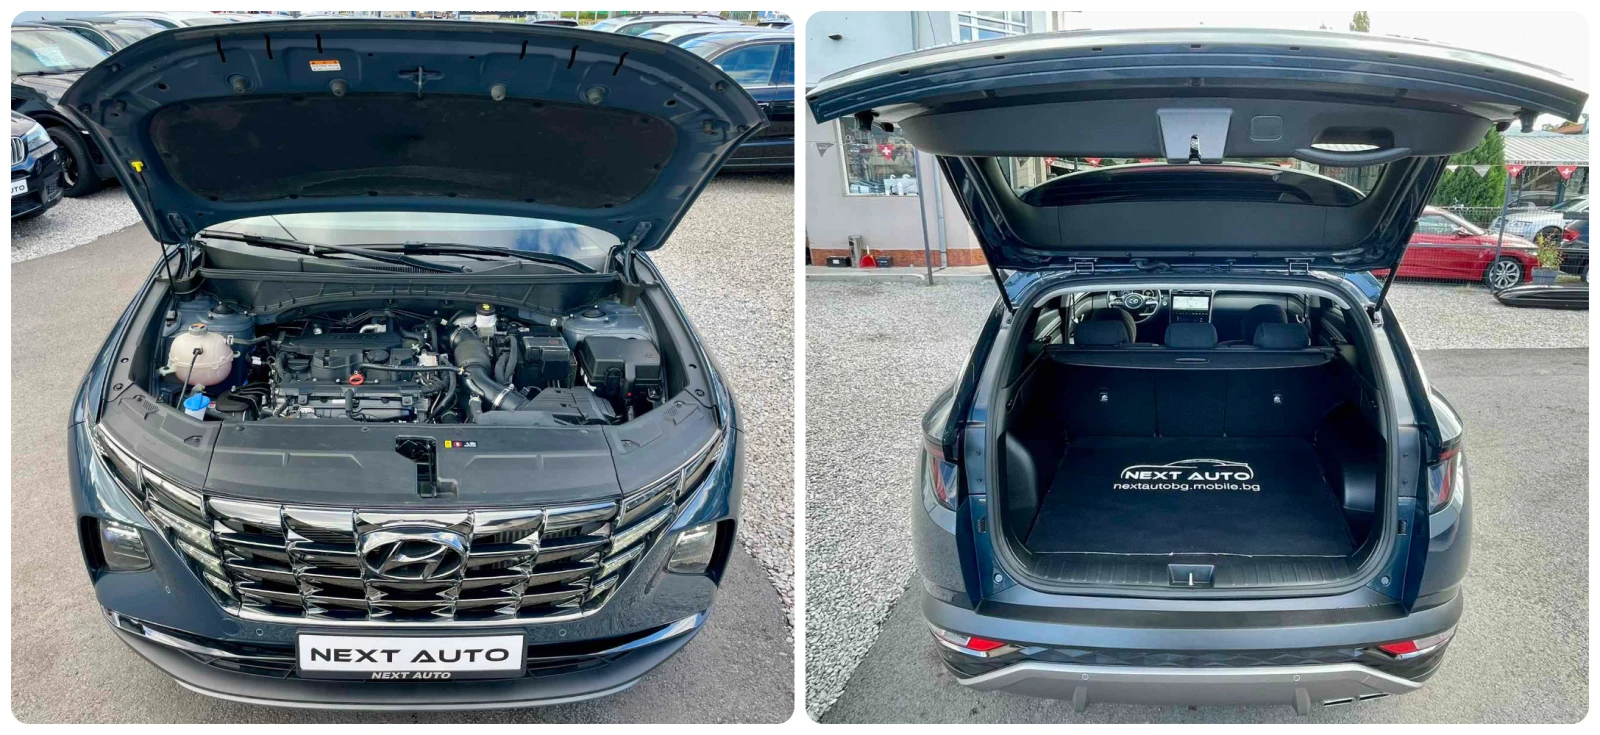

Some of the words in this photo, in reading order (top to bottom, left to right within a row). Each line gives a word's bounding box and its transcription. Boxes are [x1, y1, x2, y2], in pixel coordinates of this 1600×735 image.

[1124, 471, 1182, 480] NEXT
[1187, 472, 1251, 481] AUTO
[1113, 482, 1261, 491] nextautobg.mobile.bg
[310, 647, 401, 663] NEXT
[410, 648, 509, 663] AUTO
[371, 672, 410, 680] NEXT
[413, 672, 452, 680] AUTO
